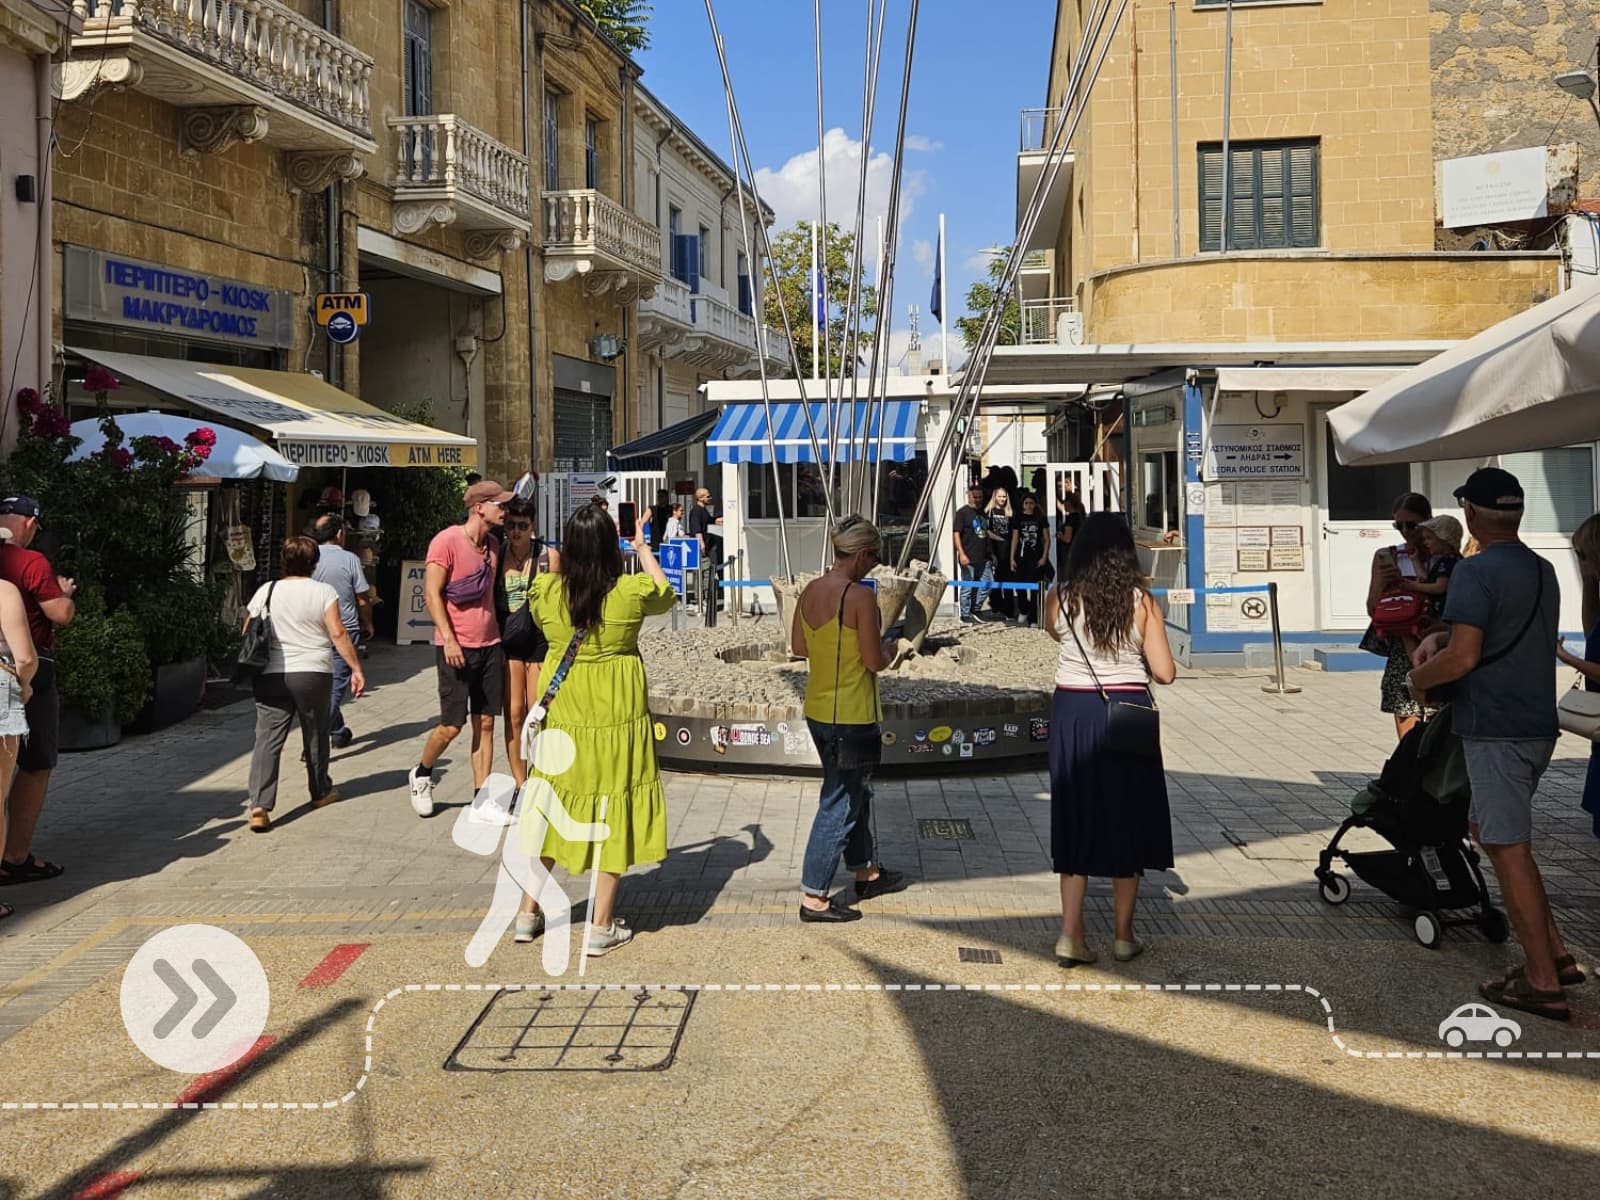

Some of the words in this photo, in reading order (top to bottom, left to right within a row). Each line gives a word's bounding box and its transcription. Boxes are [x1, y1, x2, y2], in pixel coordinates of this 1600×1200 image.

[106, 260, 209, 301] ΠΕΡΙΠΤΕΡΟ
[221, 284, 270, 312] KIOSK
[322, 296, 361, 310] ATM
[123, 296, 258, 338] ΜΑΚΡΥΔΡΟΜΟΣ
[281, 443, 348, 464] ΠΕΡΙΠΤΕΡΟ
[357, 446, 389, 464] KIOSK
[1210, 444, 1262, 452] ΑΣΤΥΝΟΜΙΚΟΣ
[1266, 443, 1301, 452] ΣΤΑΘΜΟΣ
[408, 447, 432, 464] ATM
[437, 447, 462, 464] HERE
[1212, 466, 1237, 474] LEDRA
[1270, 465, 1300, 473] STATION
[408, 568, 427, 580] AT
